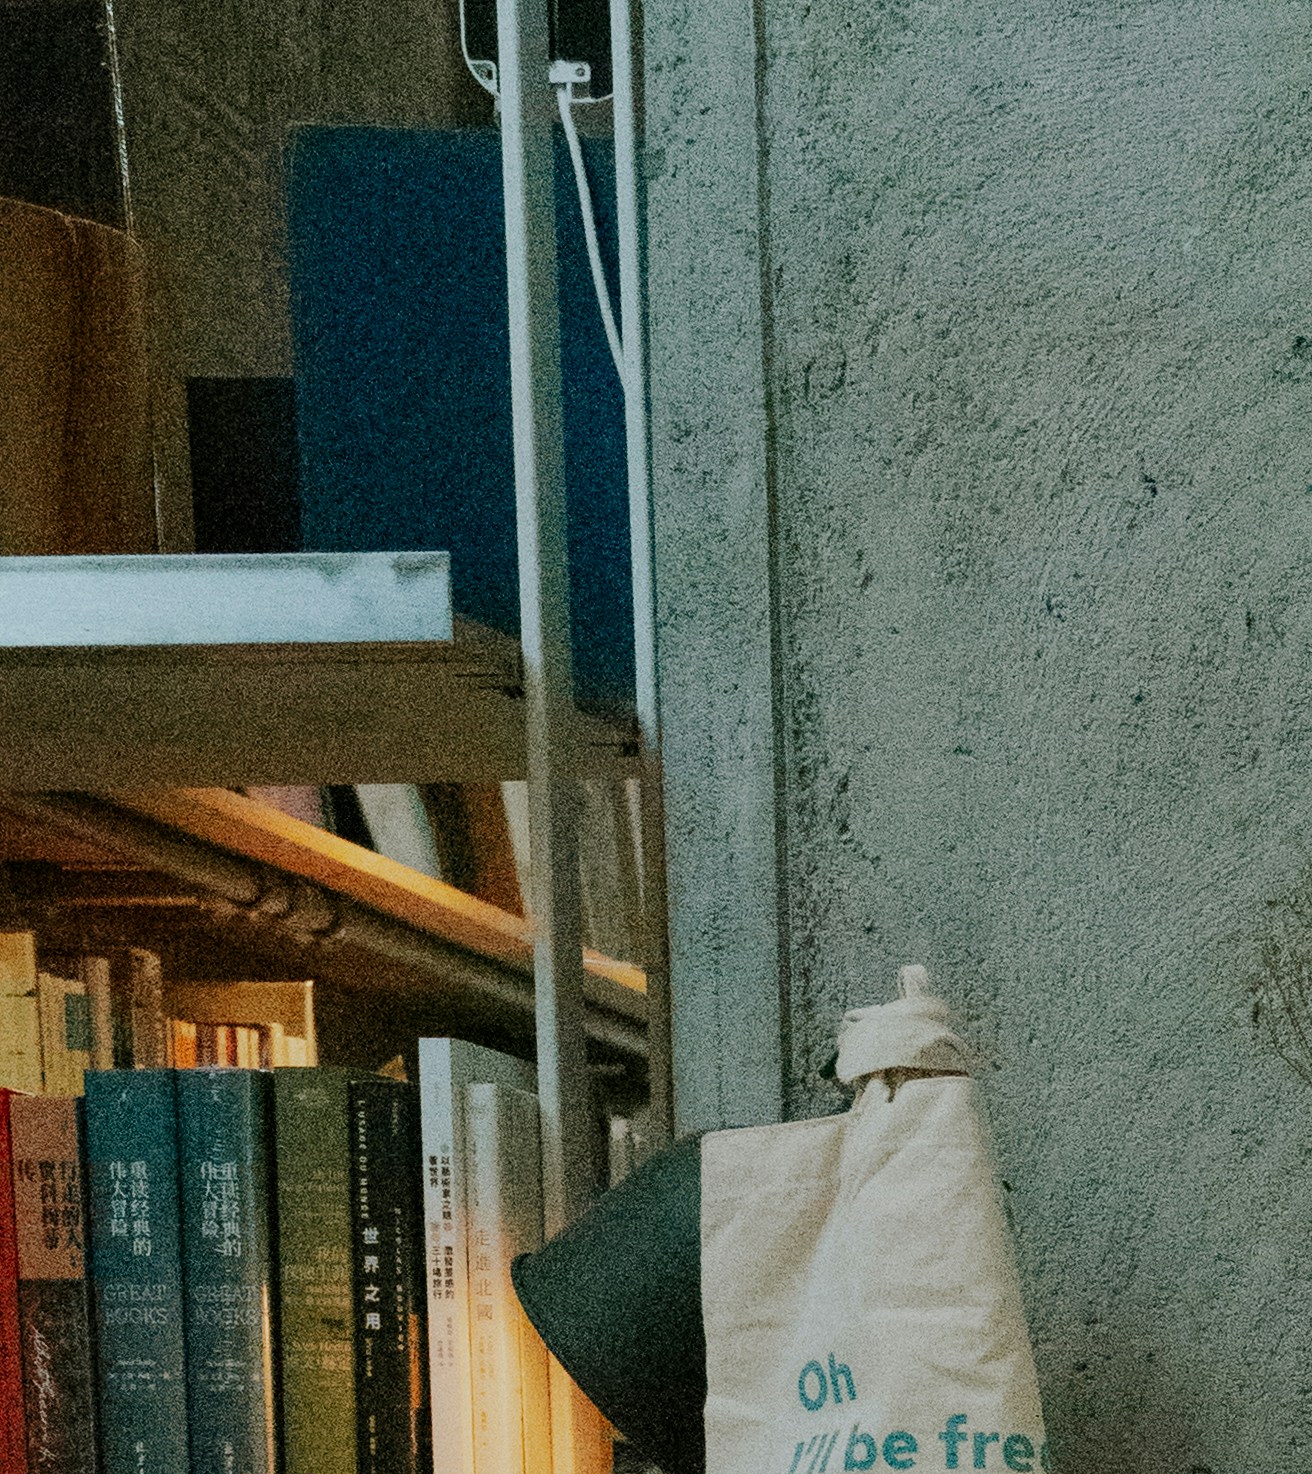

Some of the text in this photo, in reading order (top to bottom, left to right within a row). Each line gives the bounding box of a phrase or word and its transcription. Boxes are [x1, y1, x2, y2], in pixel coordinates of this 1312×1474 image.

[361, 1226, 382, 1331] 世界之用
[798, 1353, 857, 1412] Oh
[845, 1424, 918, 1474] be
